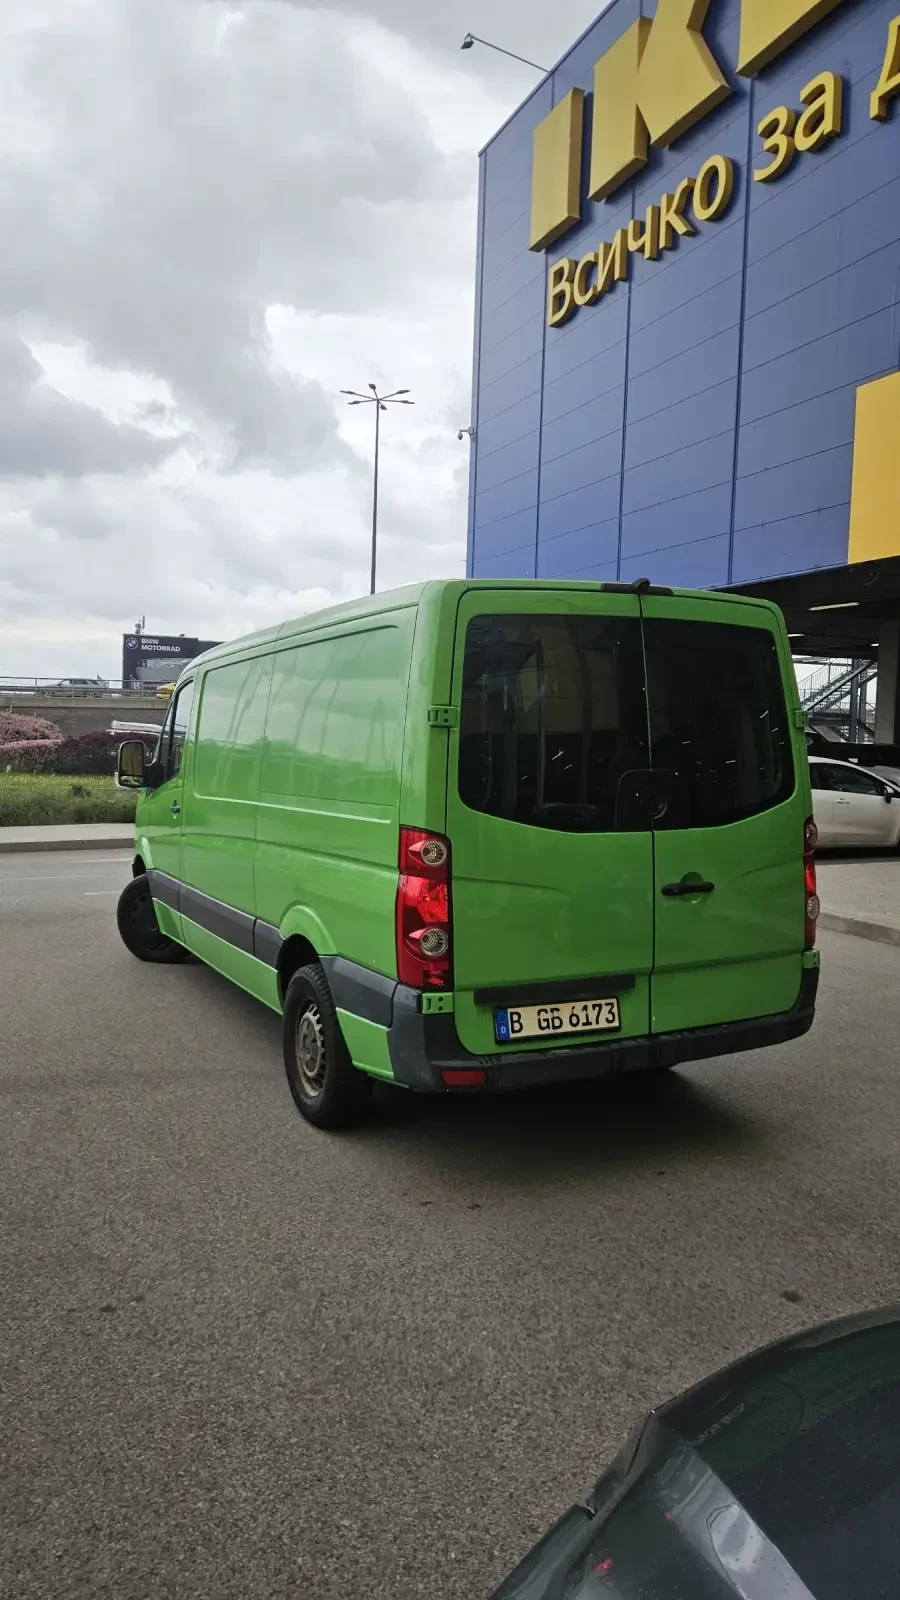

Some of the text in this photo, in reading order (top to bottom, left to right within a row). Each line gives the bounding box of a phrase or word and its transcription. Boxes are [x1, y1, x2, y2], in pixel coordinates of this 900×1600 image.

[548, 71, 844, 328] Всичко за
[509, 1011, 524, 1034] B
[537, 1007, 563, 1031] GB
[568, 1002, 616, 1028] 6173
